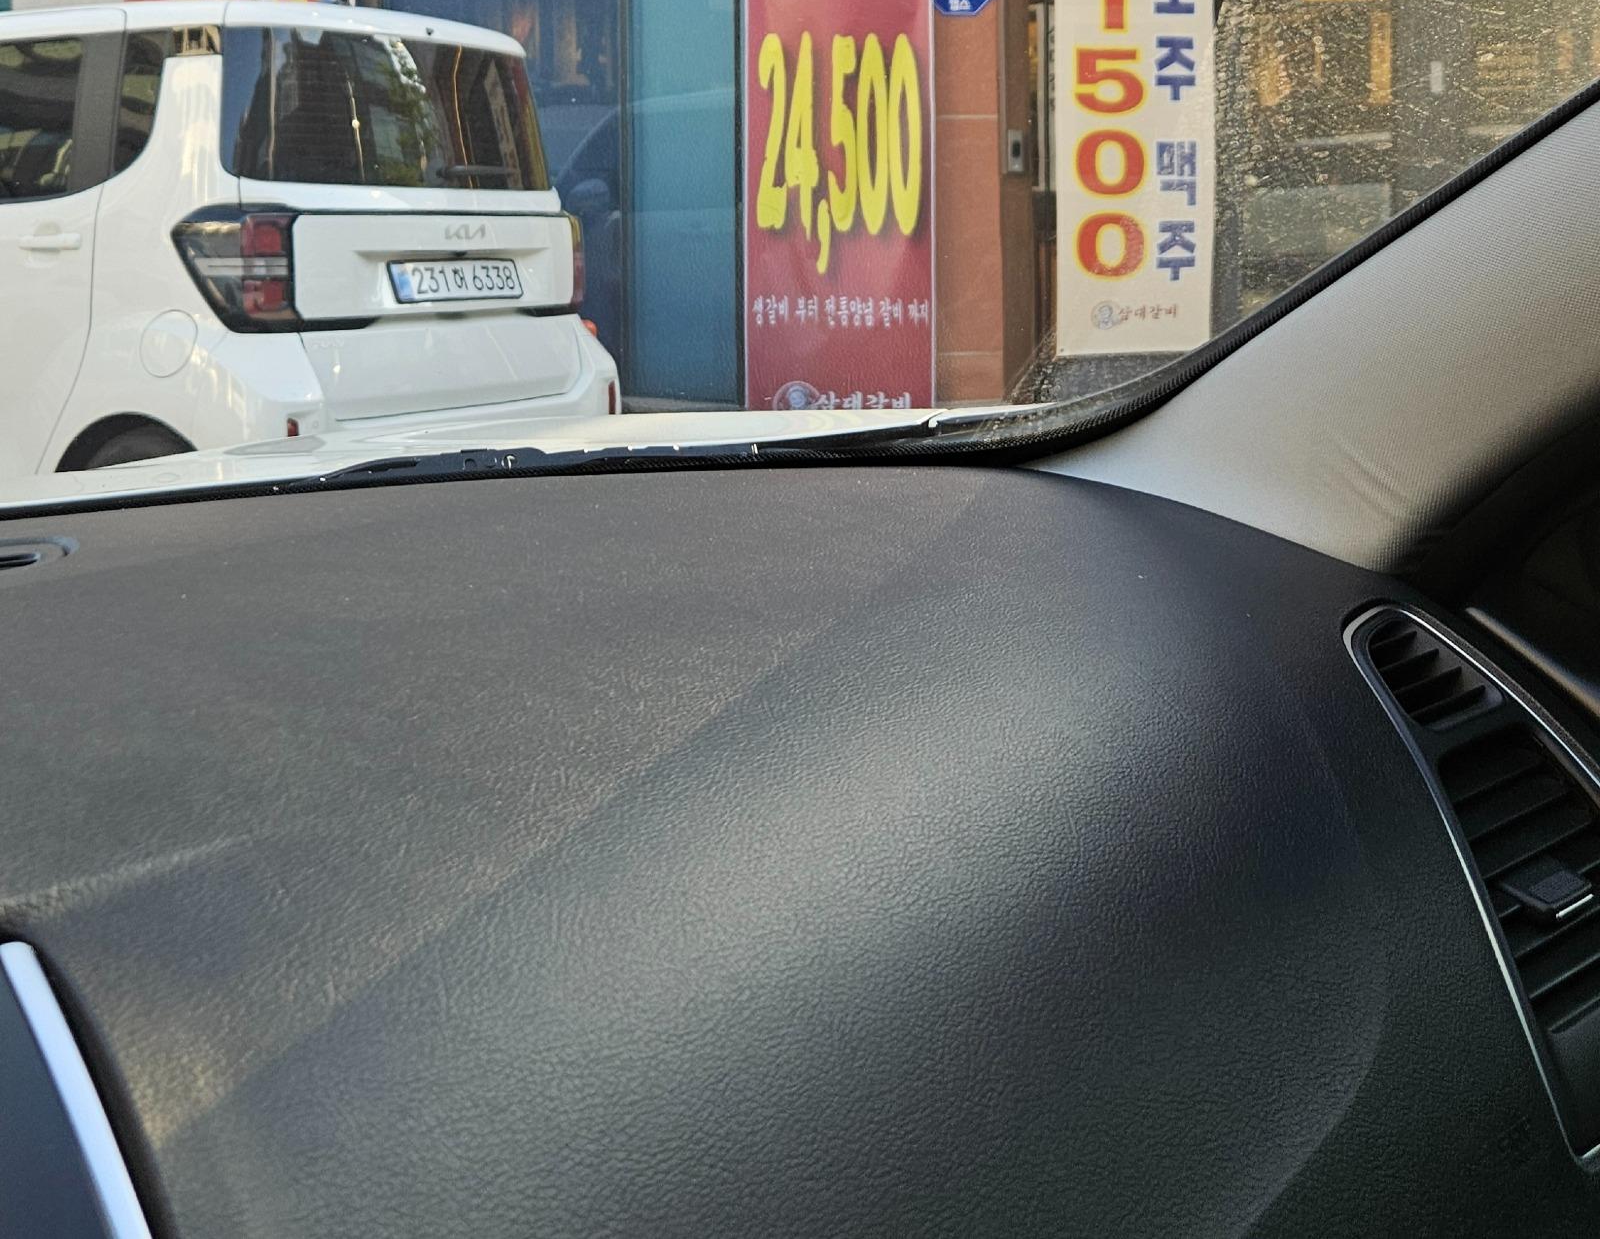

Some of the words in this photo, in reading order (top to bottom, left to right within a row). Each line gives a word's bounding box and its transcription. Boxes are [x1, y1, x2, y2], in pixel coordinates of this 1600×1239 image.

[756, 30, 922, 275] 24,500
[1154, 139, 1199, 283] 맥주
[753, 294, 789, 326] 생갈비
[796, 295, 819, 324] 부터
[879, 296, 903, 329] 갈비
